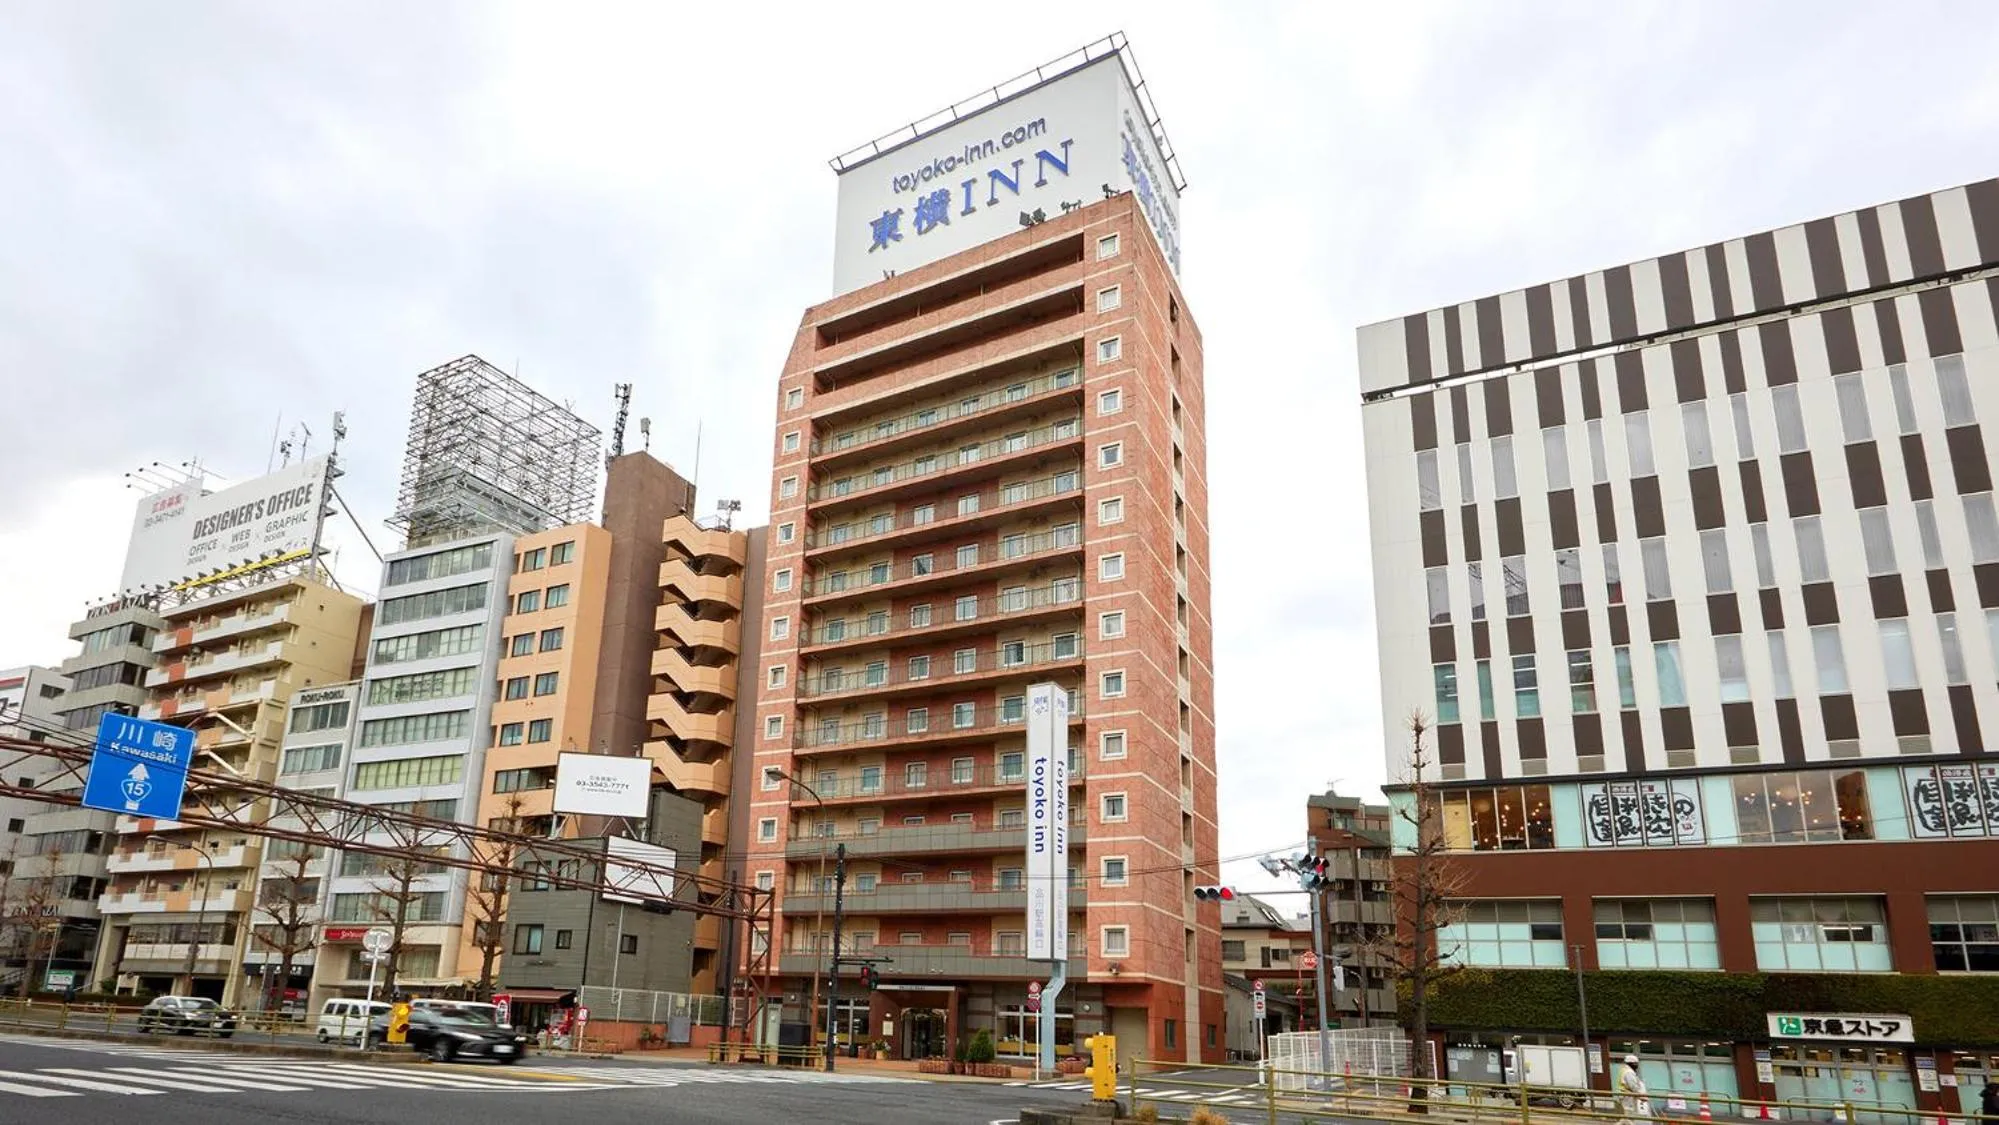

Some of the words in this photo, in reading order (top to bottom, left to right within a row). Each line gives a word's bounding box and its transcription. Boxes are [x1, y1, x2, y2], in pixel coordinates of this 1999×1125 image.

[893, 117, 1047, 194] toyoko-inn.com
[867, 138, 1074, 254] 東横INN
[192, 499, 265, 540] DESIGNER'S
[267, 483, 314, 516] OFFICE
[265, 510, 308, 533] GRAPHIC
[189, 538, 218, 556] OFFICE
[117, 722, 177, 751] 川崎
[110, 741, 177, 763] Kawasaki
[126, 782, 144, 795] 15
[1032, 757, 1048, 820] toyoko
[1057, 760, 1065, 821] toyoko
[1035, 825, 1048, 853] inn
[1057, 828, 1065, 854] inn
[1803, 1018, 1900, 1037] 京急ストア
